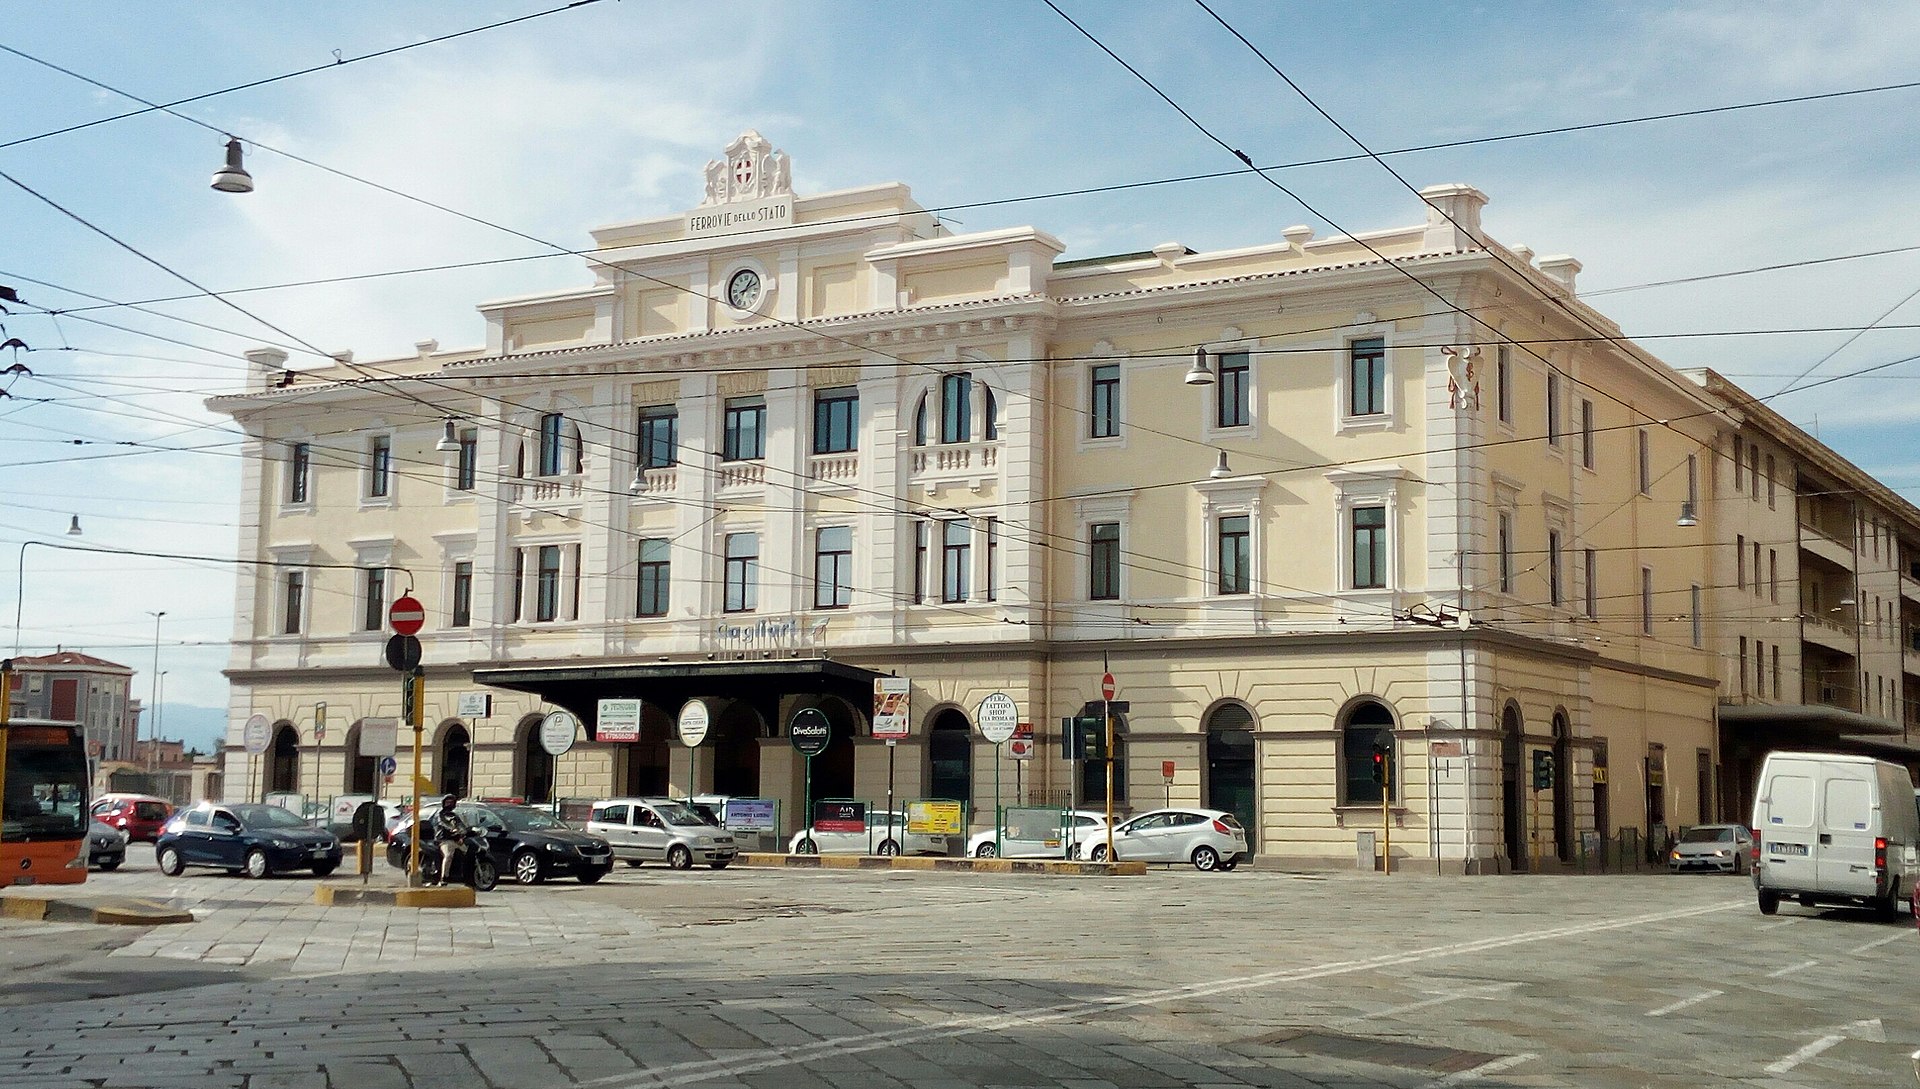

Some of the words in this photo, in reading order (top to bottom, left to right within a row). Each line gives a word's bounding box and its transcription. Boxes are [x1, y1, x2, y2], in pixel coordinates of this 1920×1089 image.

[691, 213, 731, 231] FERROVIE
[733, 211, 755, 222] DELLO
[758, 205, 786, 221] STATO
[717, 617, 796, 643] Cagliari
